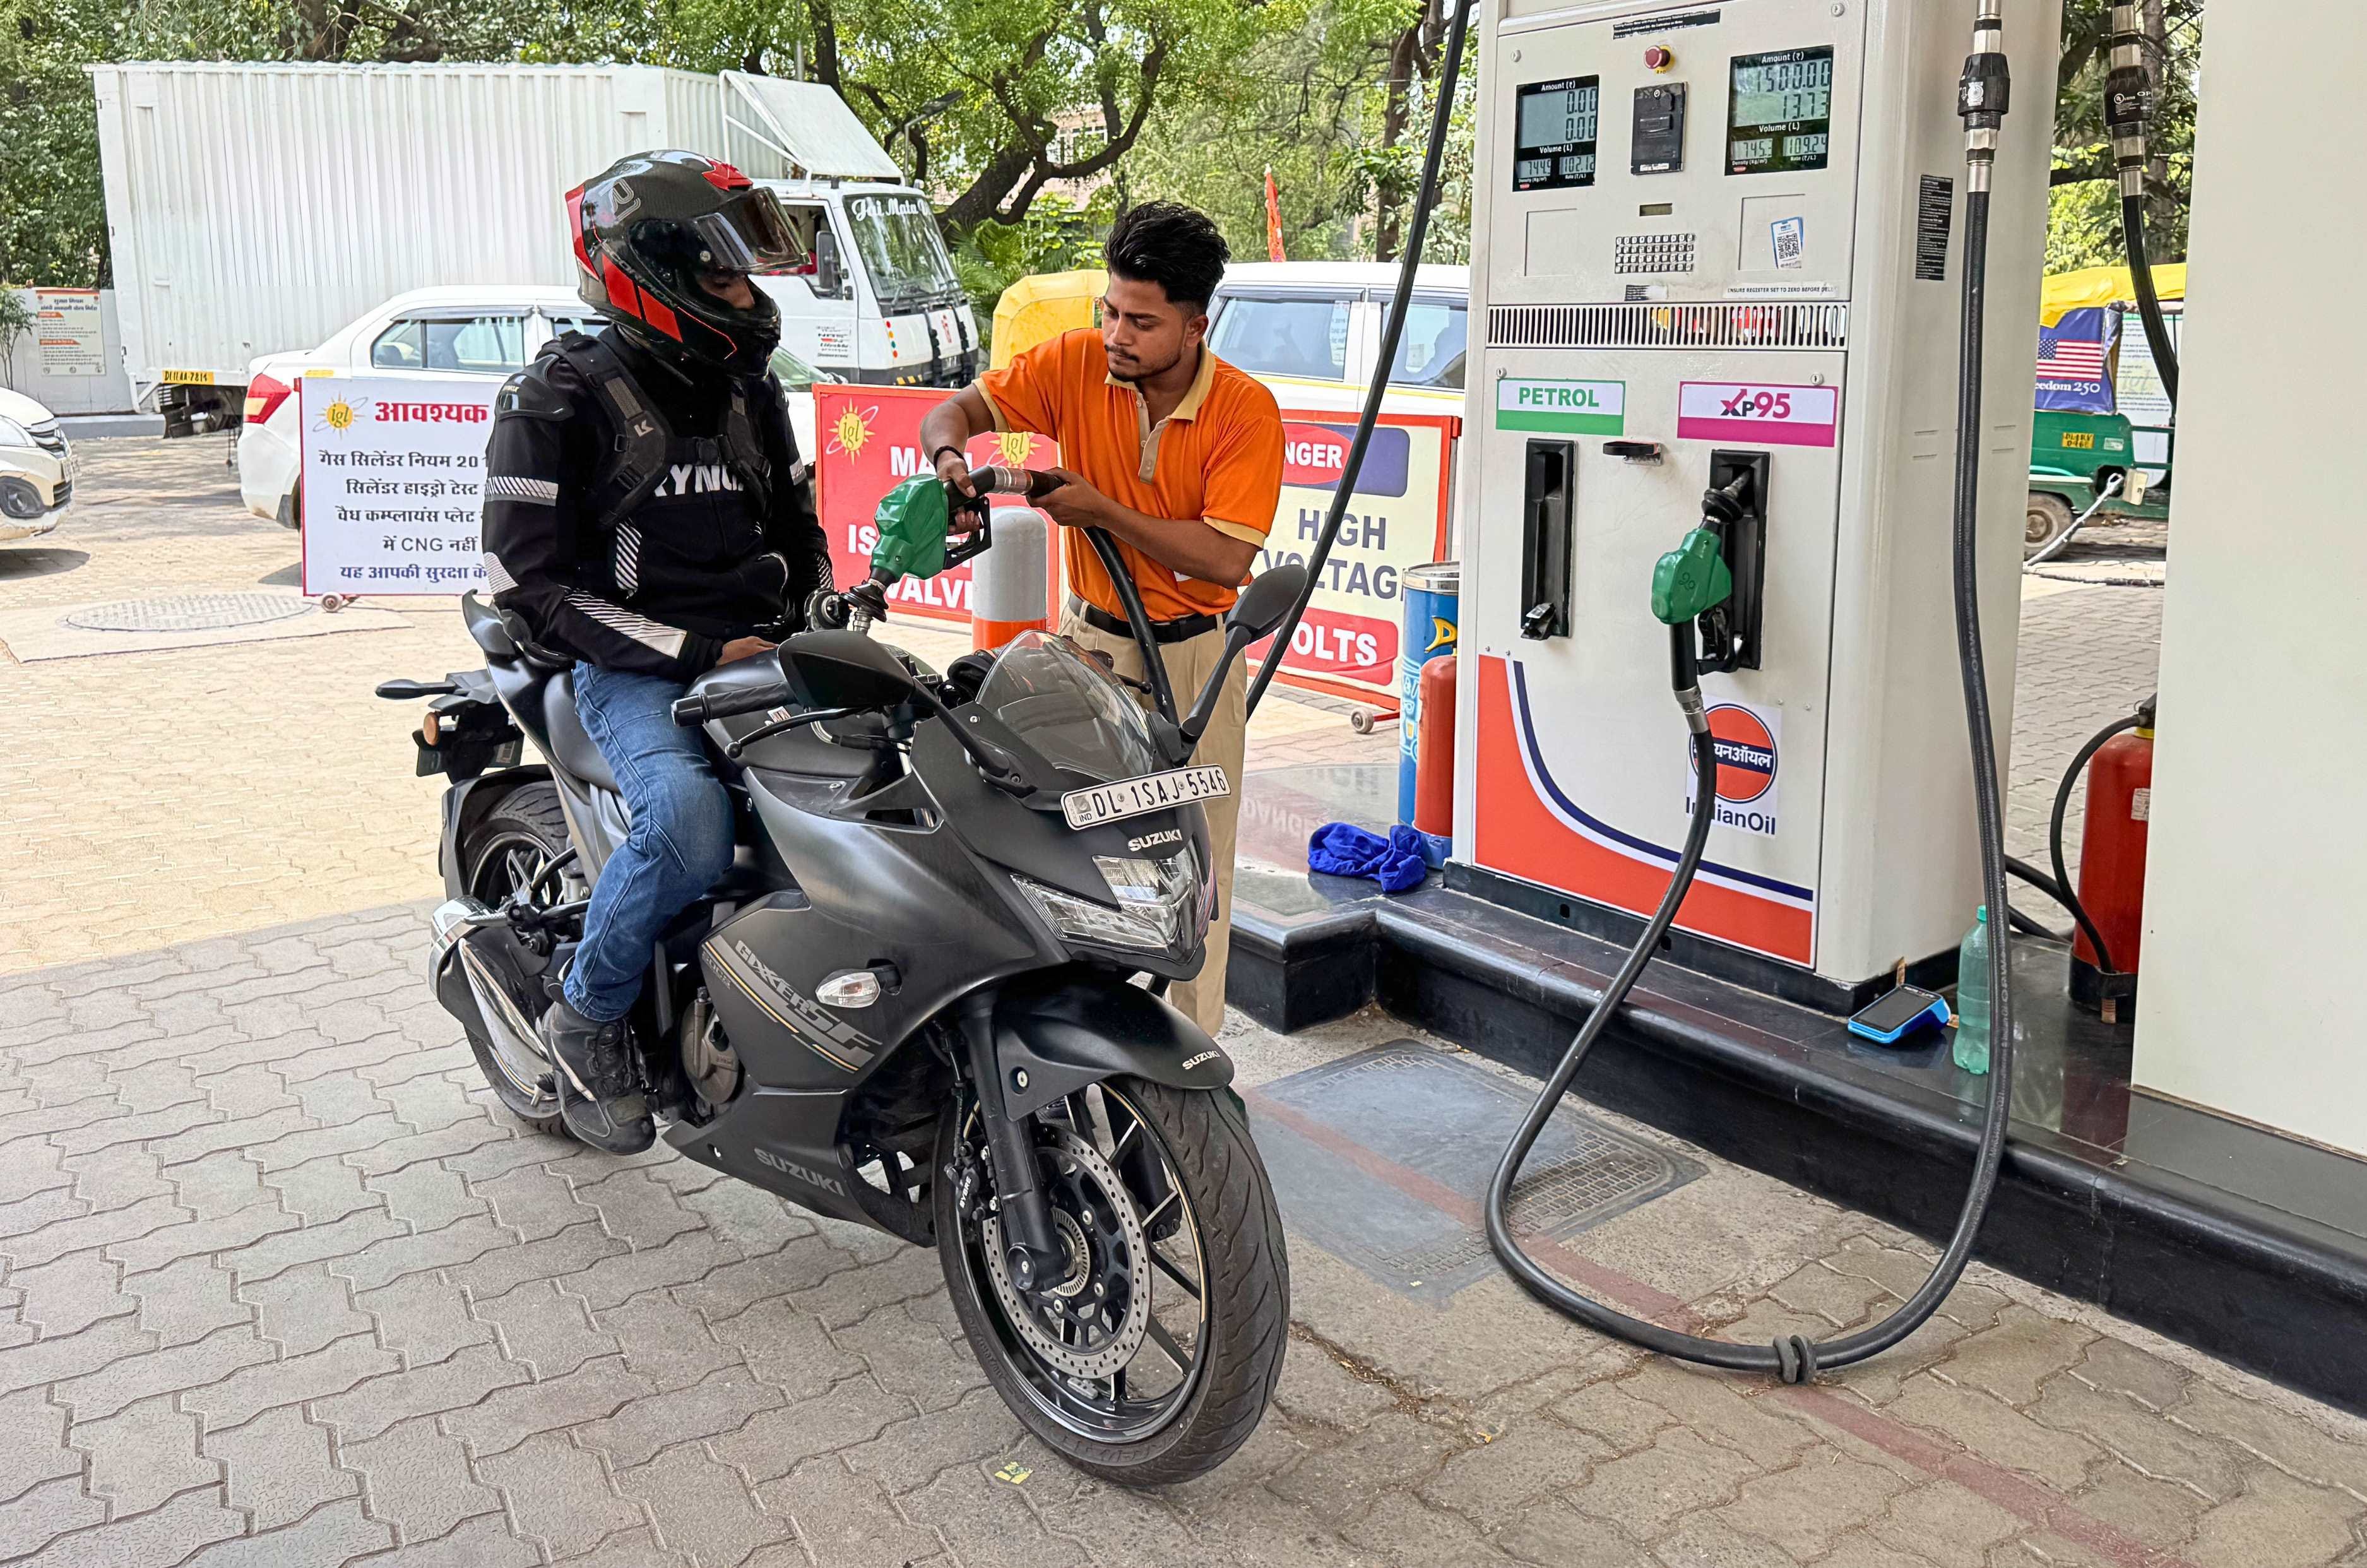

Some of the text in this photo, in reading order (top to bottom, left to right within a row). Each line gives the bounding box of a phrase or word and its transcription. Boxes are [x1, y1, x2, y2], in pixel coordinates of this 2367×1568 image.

[1762, 53, 1790, 64] Amount
[1541, 81, 1564, 91] Amount
[1757, 60, 1830, 93] 1500.00
[1567, 88, 1597, 114] 0.00
[1783, 90, 1829, 119] 13.73
[1565, 115, 1596, 141] 0.00
[1759, 122, 1800, 133] Volume (L)
[1539, 144, 1573, 154] Volume (L)
[1518, 386, 1599, 408] PETROL
[2072, 381, 2101, 396] 250
[331, 404, 349, 429] igl
[375, 402, 489, 423] आवश्यक
[841, 415, 860, 452] igl
[318, 450, 346, 466] गैस
[350, 450, 403, 468] सिलेंडर
[409, 451, 451, 468] नियम
[347, 478, 478, 499] सिलेंडर हाइड्रो टेस्ट
[335, 505, 361, 521] वैध
[444, 507, 476, 523] प्लेट
[383, 535, 478, 552] में CNG नहीं
[340, 566, 364, 579] यह
[369, 563, 421, 579] आपकी
[426, 566, 468, 583] सुरक्षा
[1091, 790, 1122, 817] DL
[1185, 769, 1226, 796] 5546
[1079, 812, 1093, 823] IND
[1686, 797, 1776, 835] IianOil
[1128, 829, 1182, 852] SUZUKI
[1182, 1050, 1221, 1070] SUZUKI
[754, 1146, 845, 1197] SUZUKI
